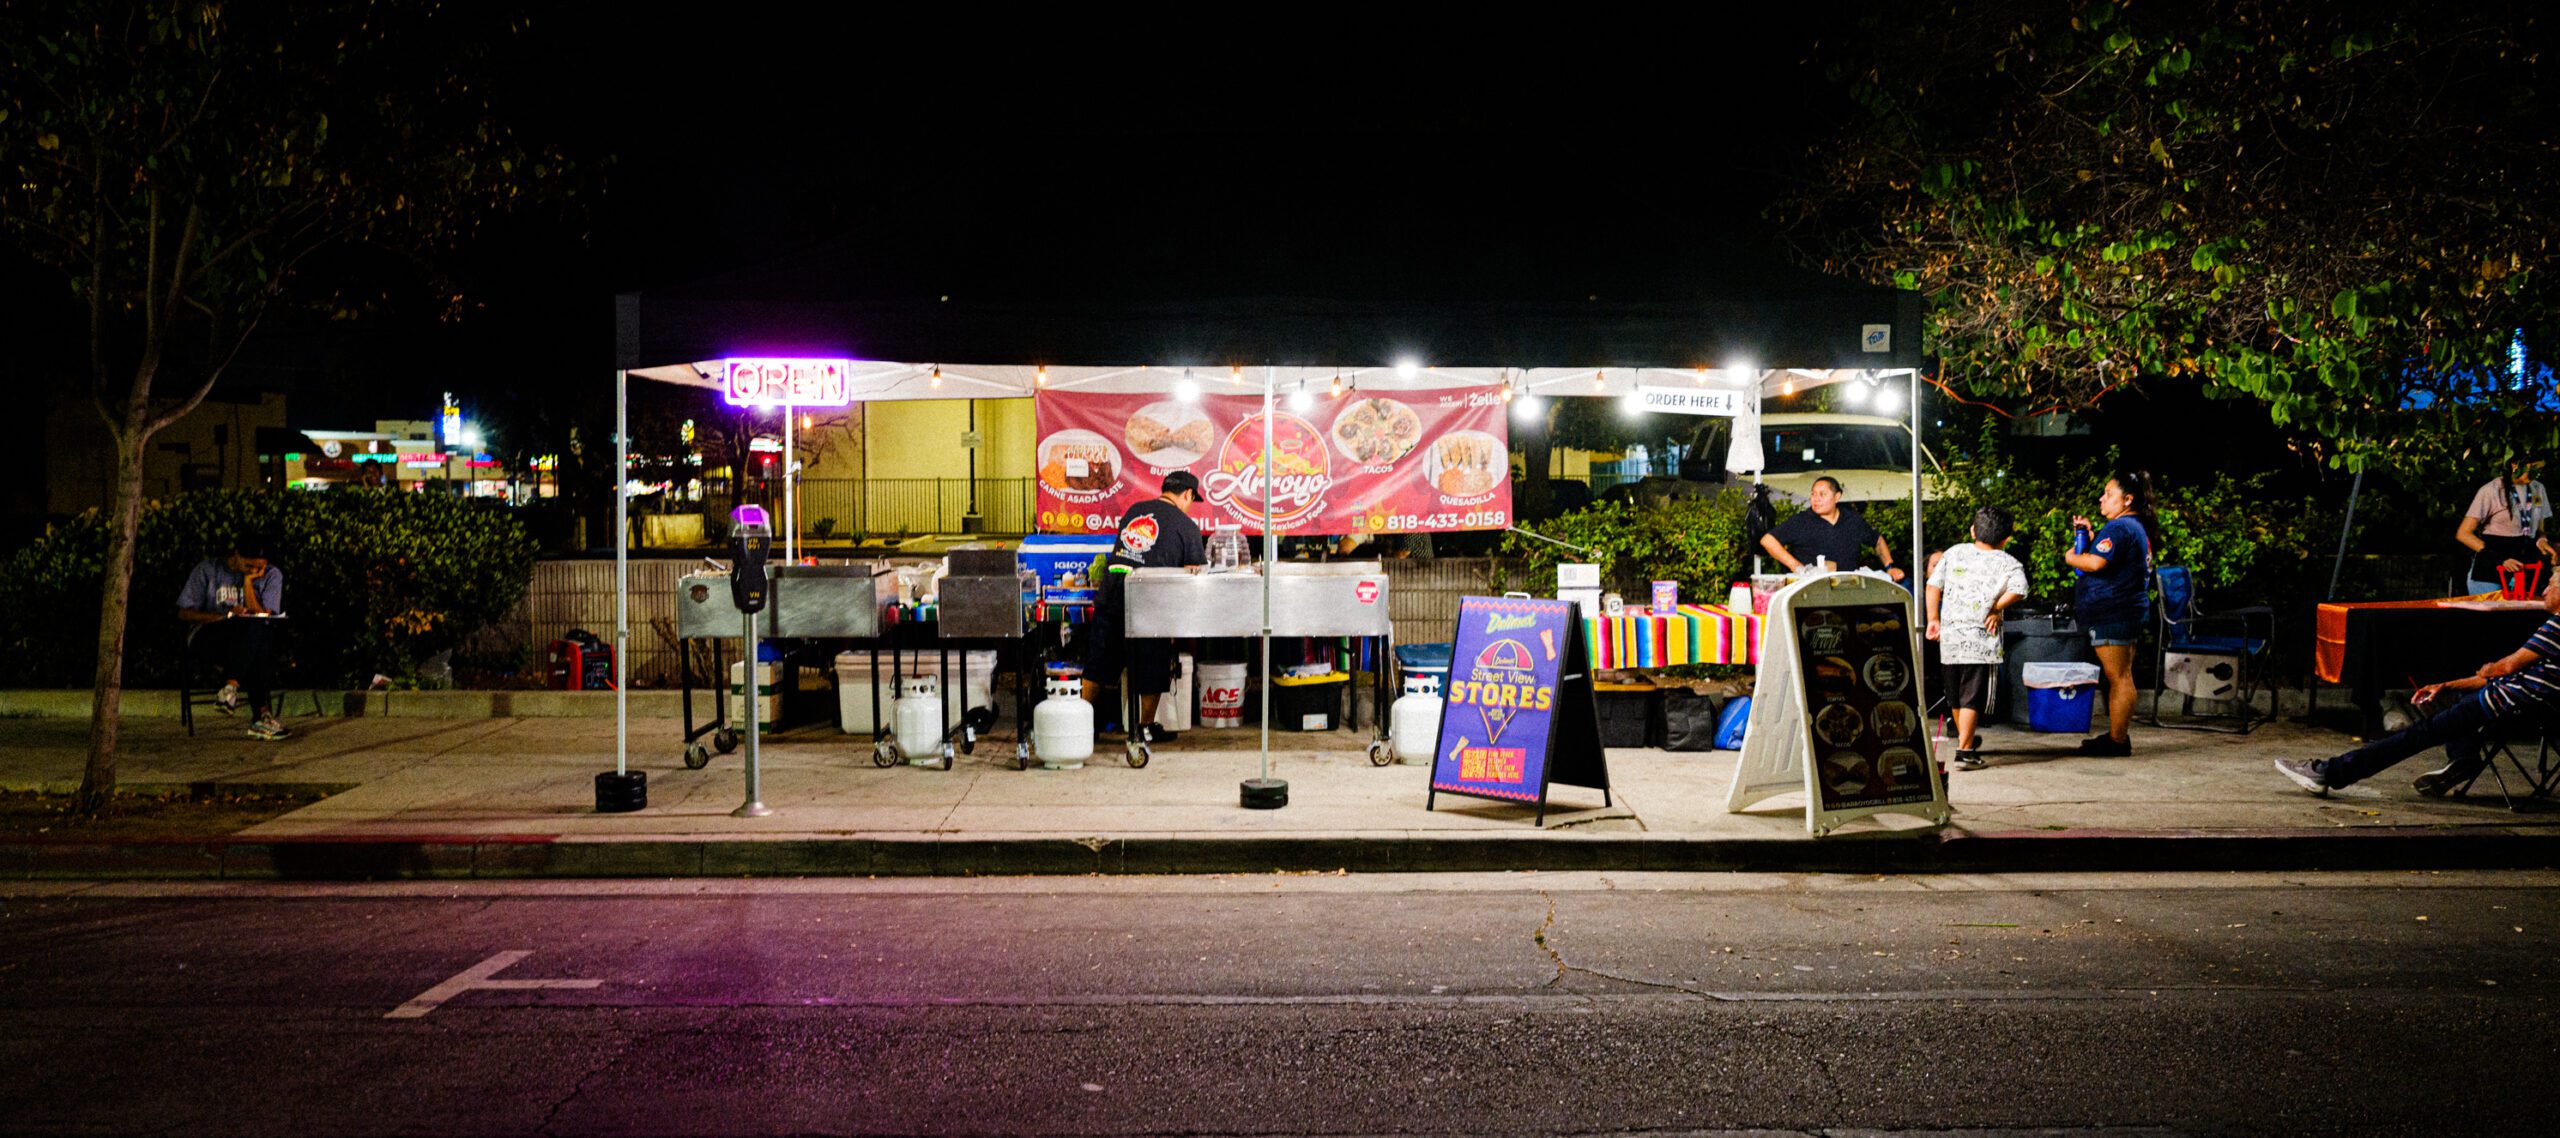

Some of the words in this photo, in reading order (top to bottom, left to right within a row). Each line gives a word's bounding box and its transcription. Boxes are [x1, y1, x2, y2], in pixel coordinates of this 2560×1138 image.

[731, 362, 843, 400] OPEN
[1469, 393, 1501, 408] Zelle
[1645, 393, 1686, 407] ORDER
[1690, 395, 1720, 408] HERE
[1363, 464, 1393, 474] TACOS
[1039, 479, 1066, 499] CARNE
[1067, 494, 1098, 504] ASADA
[1098, 481, 1124, 501] PLATE
[1439, 493, 1496, 506] QUESADILLA
[1223, 503, 1265, 530] Authentic
[1306, 502, 1328, 521] Food
[1386, 511, 1506, 530] 818-433-0158
[1471, 668, 1504, 682] Street
[1508, 670, 1535, 684] View
[1202, 685, 1240, 704] ACE
[1449, 680, 1552, 710] STORES
